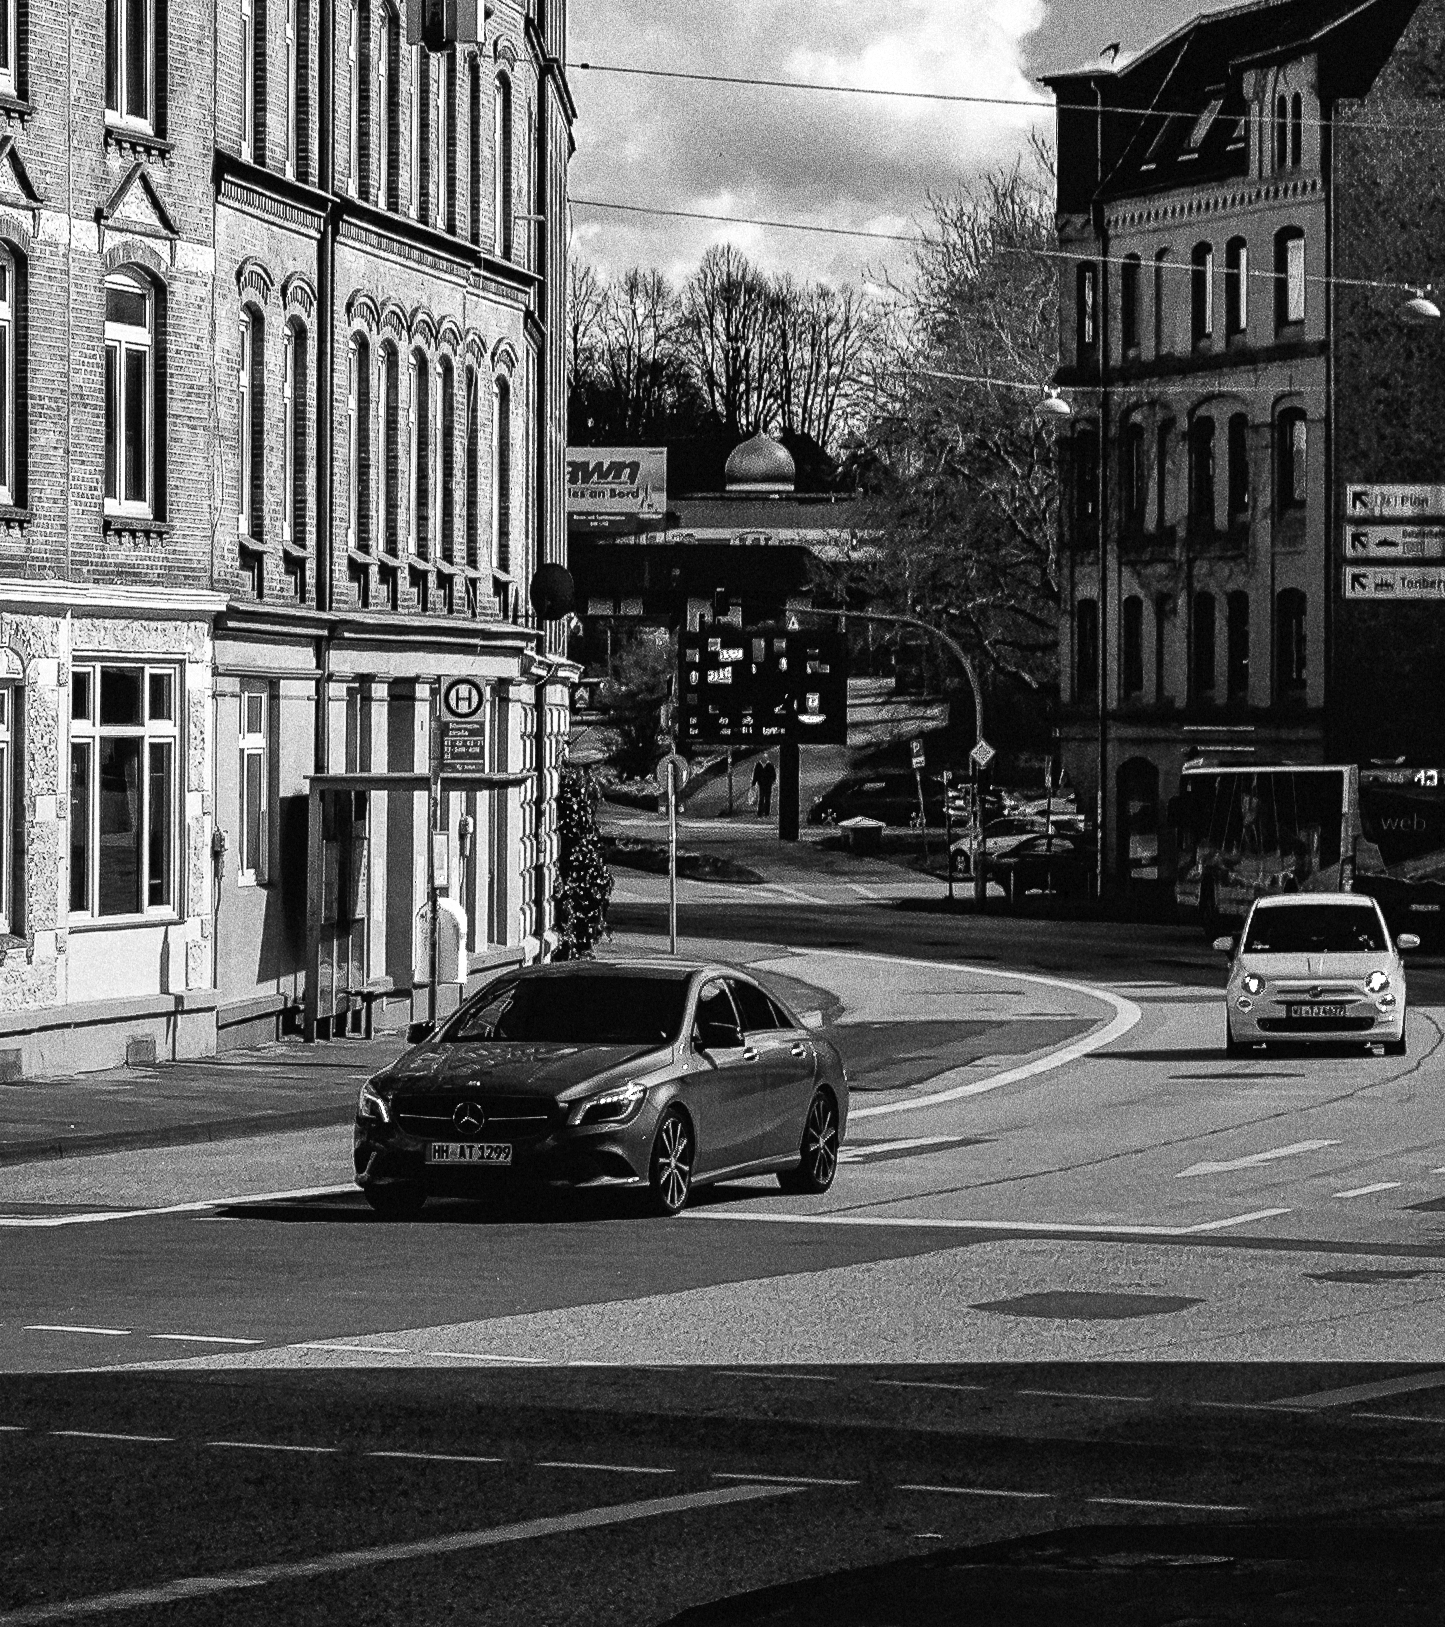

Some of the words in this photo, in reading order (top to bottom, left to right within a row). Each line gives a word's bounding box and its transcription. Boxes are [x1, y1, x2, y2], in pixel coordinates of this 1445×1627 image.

[433, 1144, 450, 1160] HH
[458, 1144, 475, 1161] AT
[478, 1144, 512, 1161] 1299
